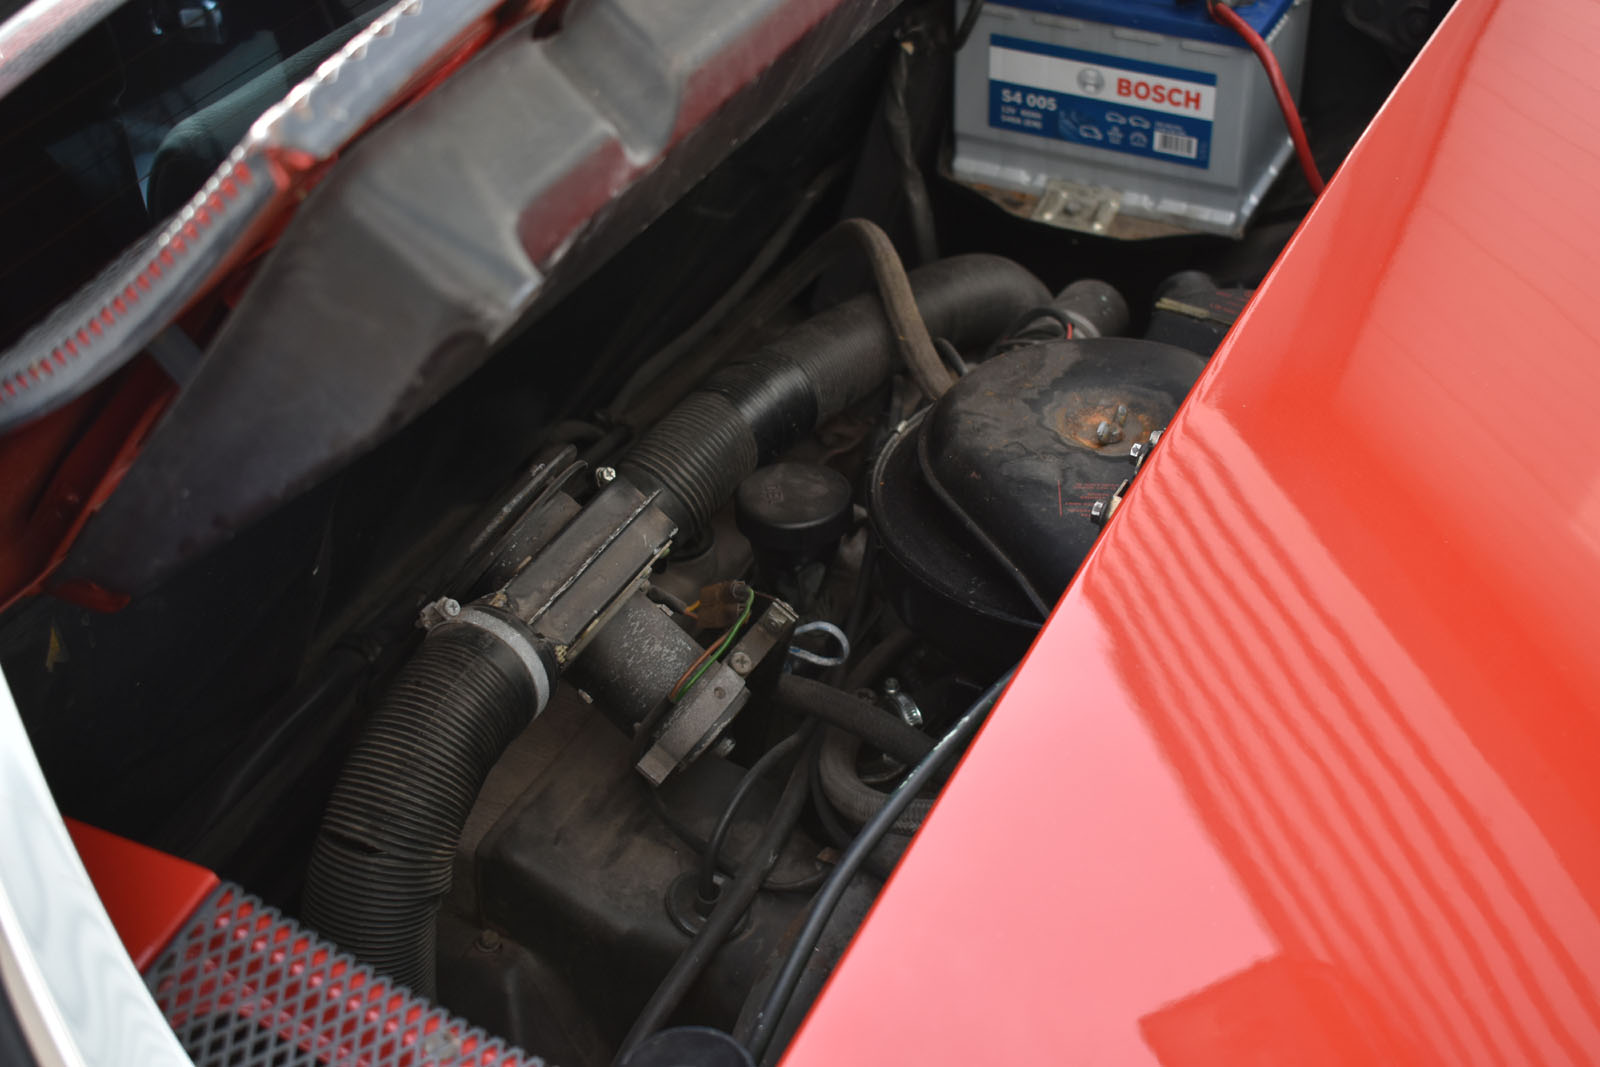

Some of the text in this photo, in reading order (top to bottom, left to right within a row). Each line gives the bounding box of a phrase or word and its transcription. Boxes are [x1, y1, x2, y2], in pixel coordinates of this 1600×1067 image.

[1001, 88, 1057, 112] S4 005
[1117, 78, 1201, 111] BOSCH
